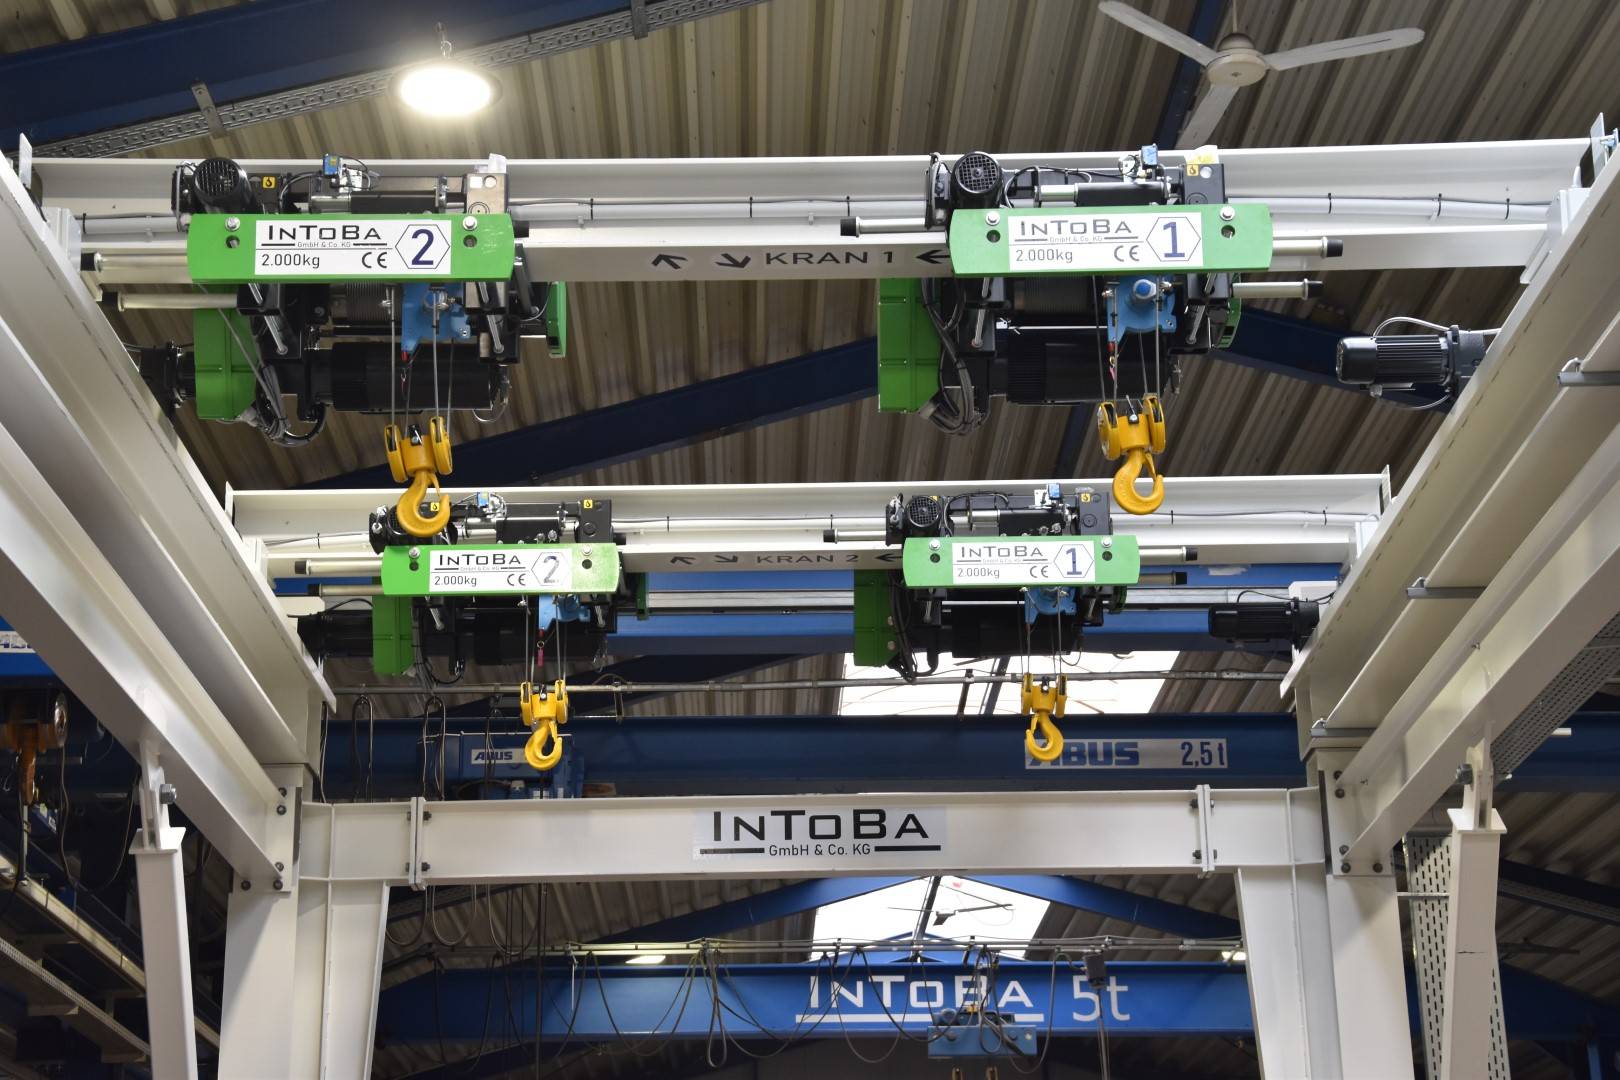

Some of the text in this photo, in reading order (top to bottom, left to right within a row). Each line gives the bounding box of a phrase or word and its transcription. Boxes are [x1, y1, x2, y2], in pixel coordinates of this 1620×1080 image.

[410, 228, 435, 266] 2
[1162, 221, 1186, 258] 1
[261, 253, 320, 269] 2.000kg
[765, 251, 893, 265] KRAN 1
[1015, 248, 1073, 264] 2.000kg
[757, 554, 859, 564] KRAN 2
[1065, 547, 1083, 576] 1
[543, 555, 560, 584] 2
[957, 567, 1000, 579] 2.000kg
[434, 575, 477, 587] 2.000kg
[769, 843, 871, 857] GmbH & Co. KG
